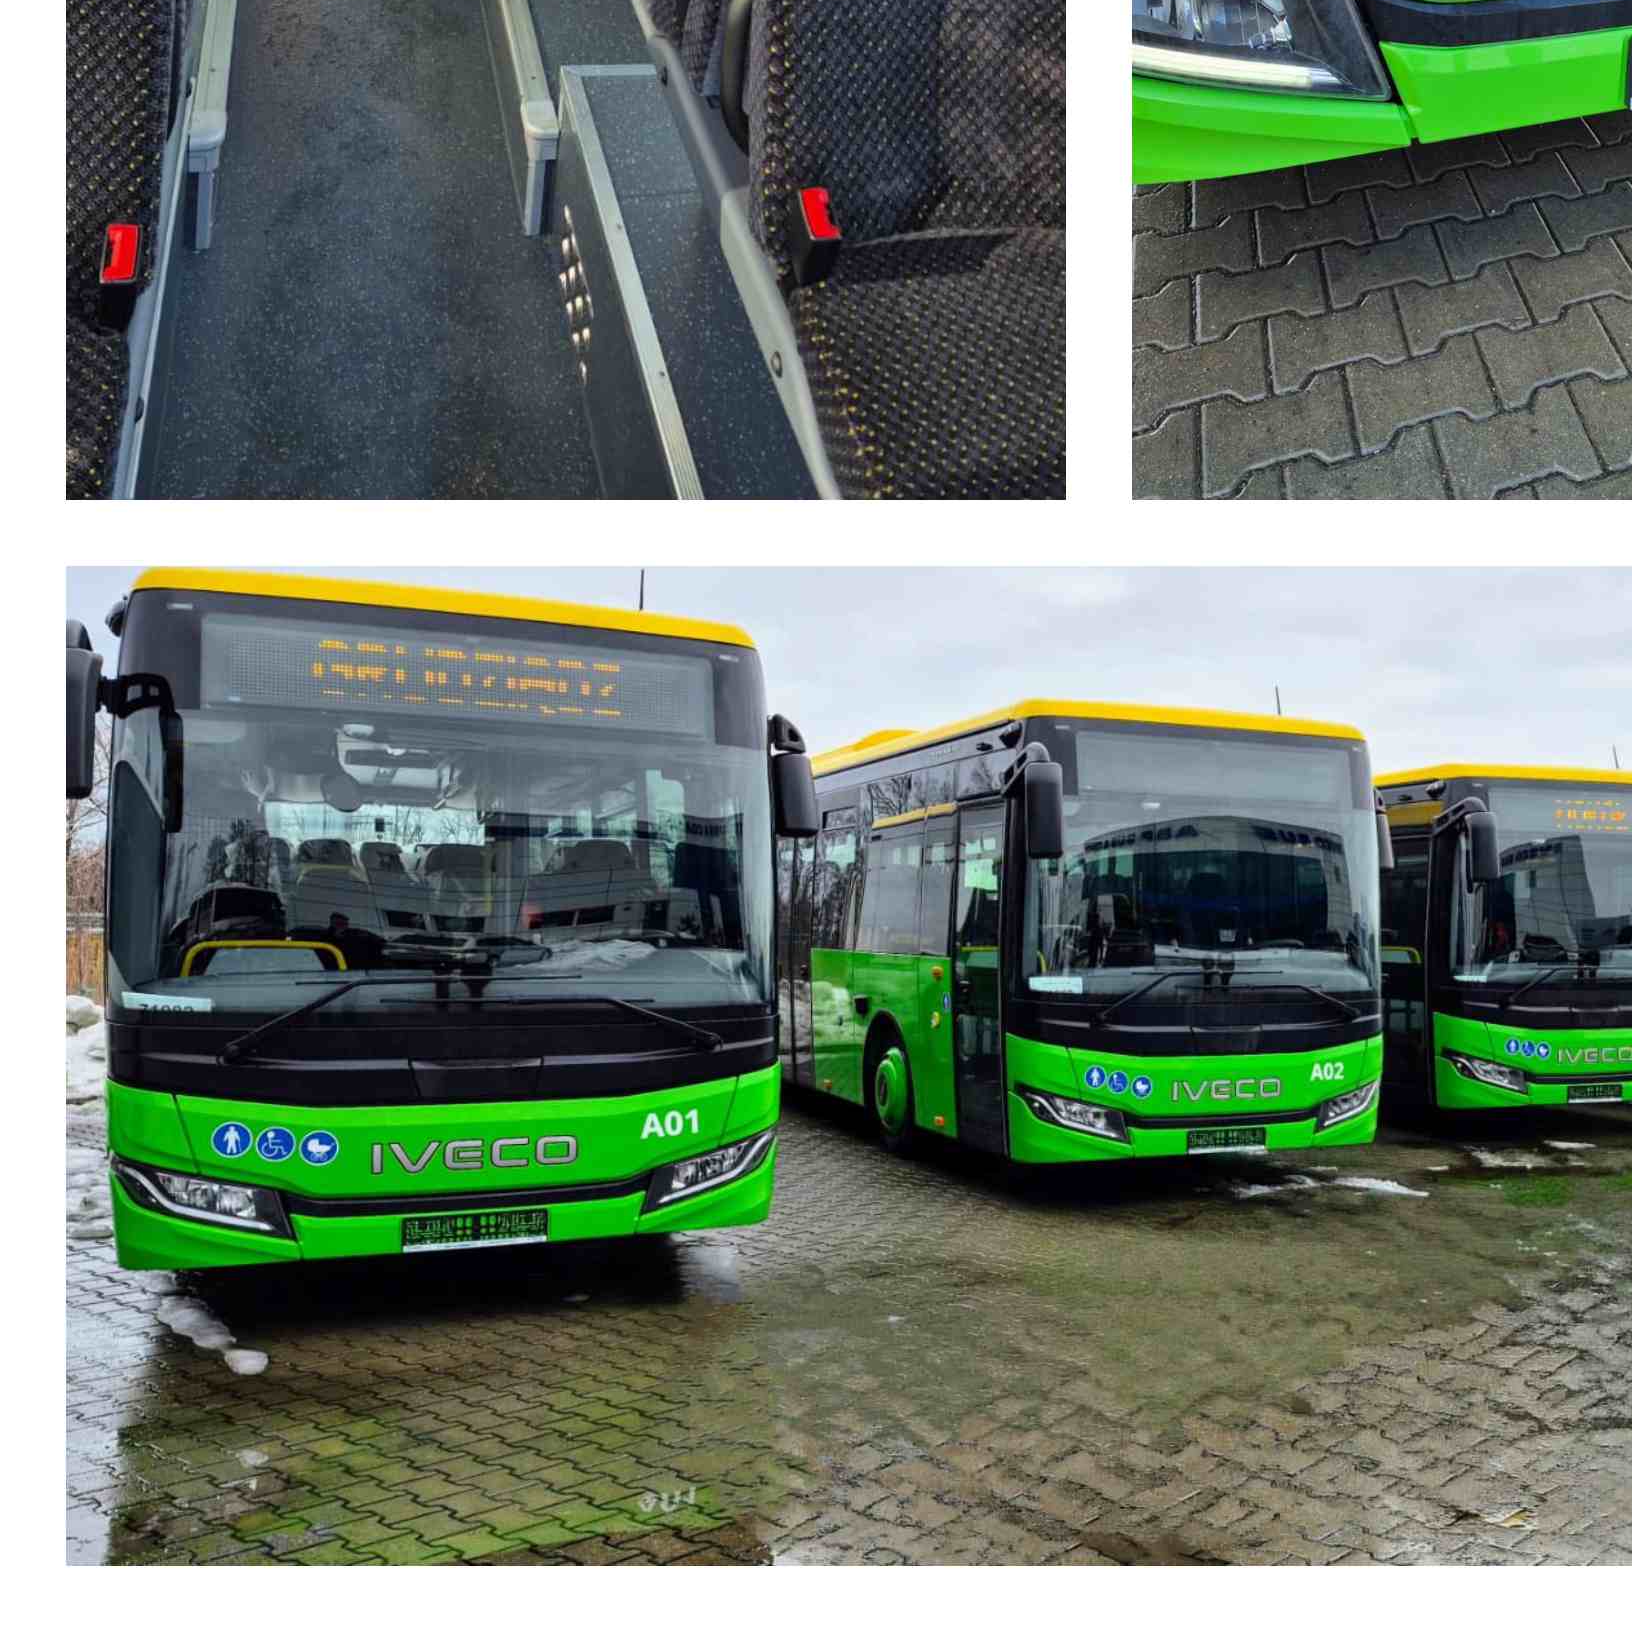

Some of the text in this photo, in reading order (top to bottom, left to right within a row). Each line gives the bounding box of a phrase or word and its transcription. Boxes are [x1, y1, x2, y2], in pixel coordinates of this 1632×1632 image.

[1310, 1062, 1345, 1081] A02
[1171, 1077, 1282, 1103] IVECO
[640, 1108, 701, 1139] A01
[371, 1135, 579, 1175] IVECO
